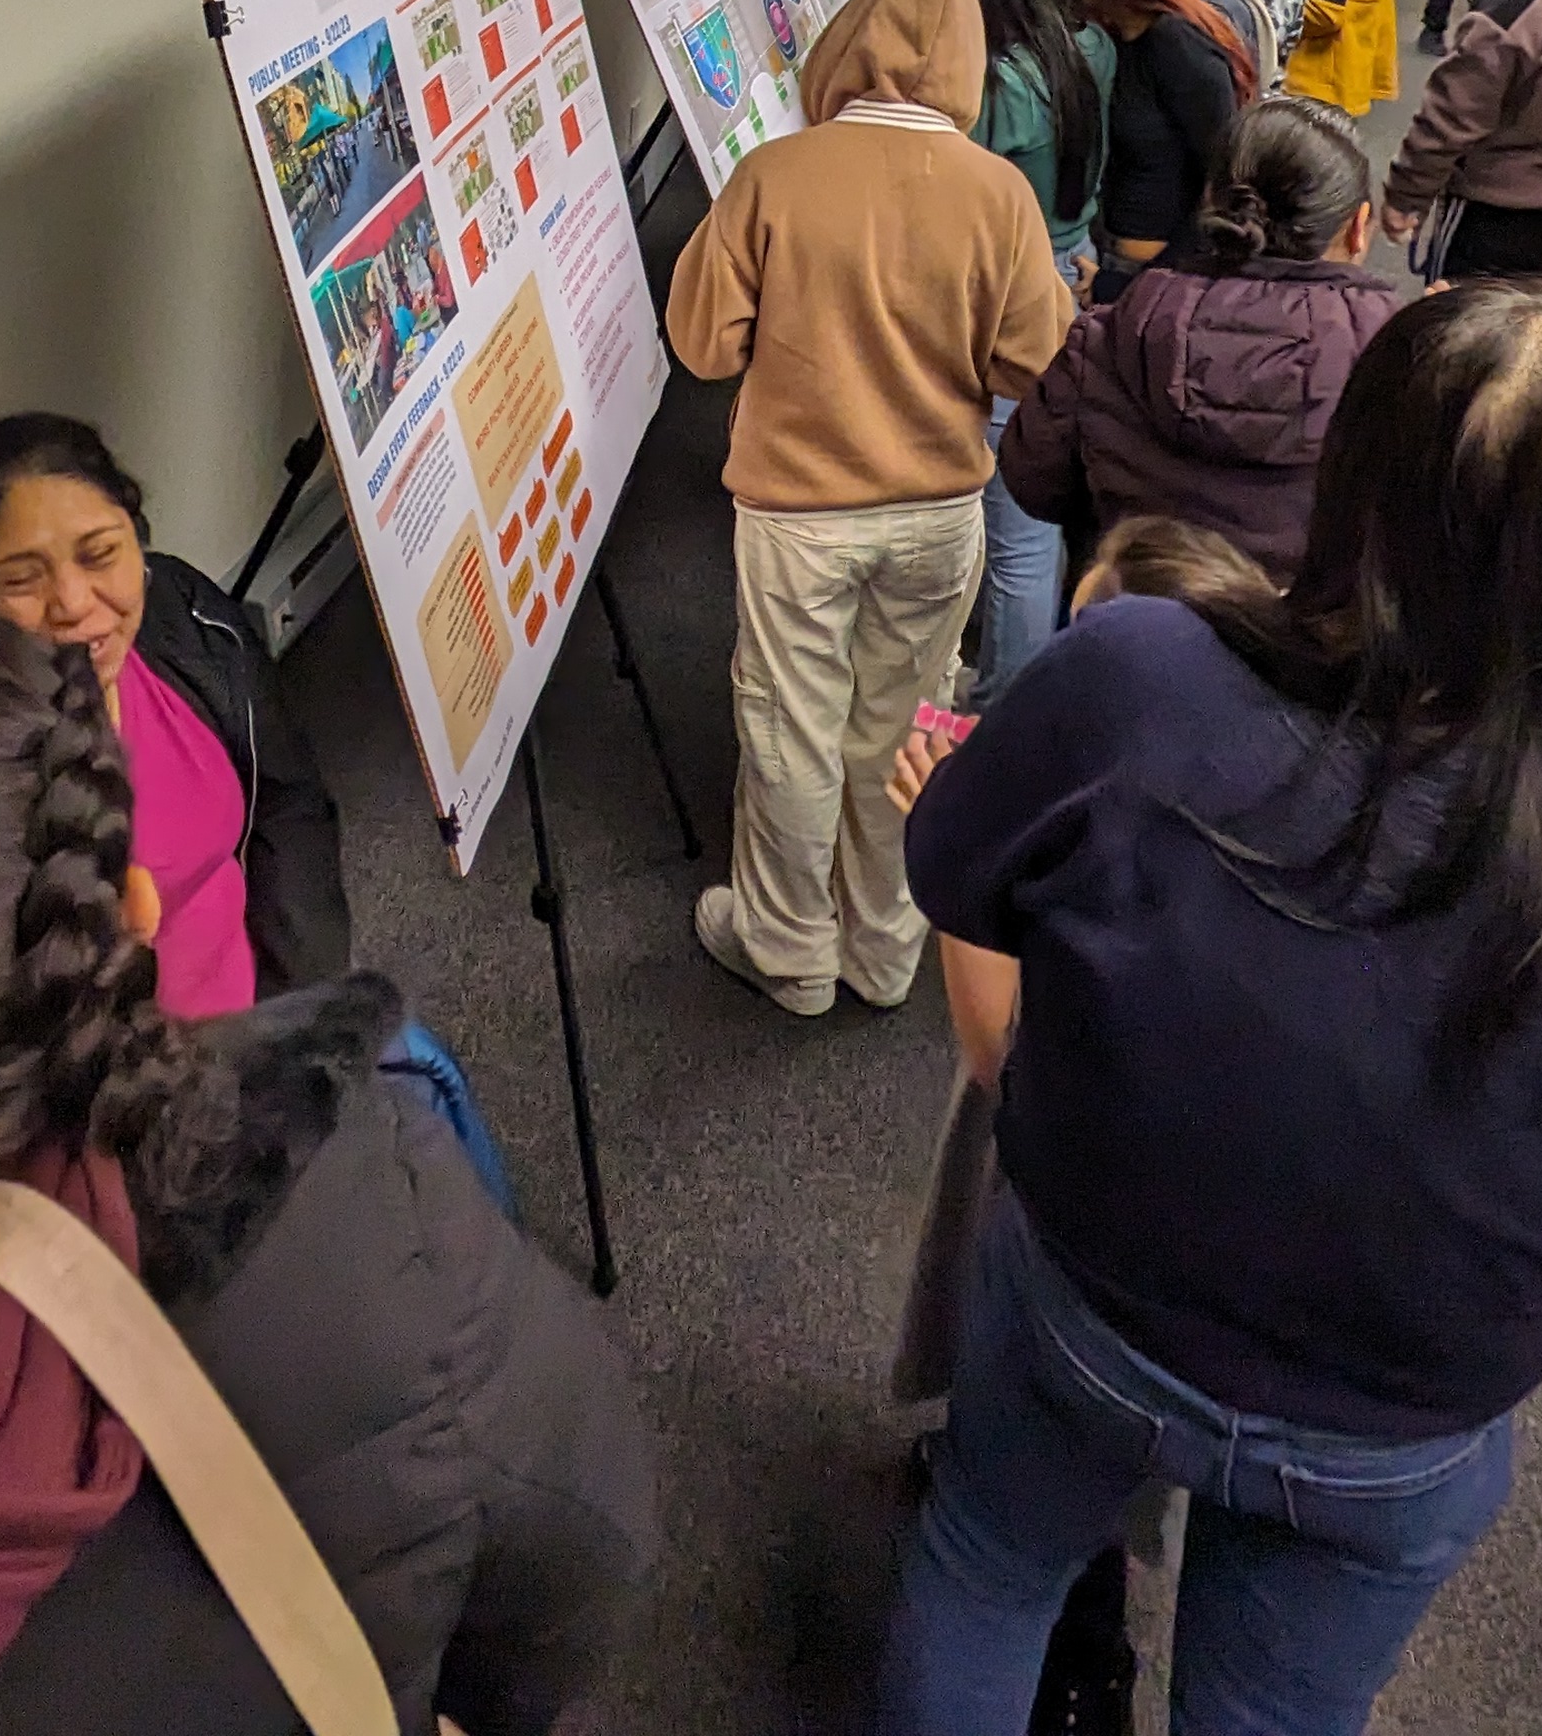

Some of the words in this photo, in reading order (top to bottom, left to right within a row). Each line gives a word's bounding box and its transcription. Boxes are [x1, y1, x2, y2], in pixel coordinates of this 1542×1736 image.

[248, 60, 281, 96] PUBLIC
[280, 36, 320, 74] MEETING
[468, 359, 496, 404] COMMUNITY
[495, 332, 513, 363] GARDEN
[367, 453, 392, 500] DESIGN
[389, 420, 410, 462] EVENT
[408, 375, 441, 430] FEEDBACK
[475, 422, 491, 450] MORE
